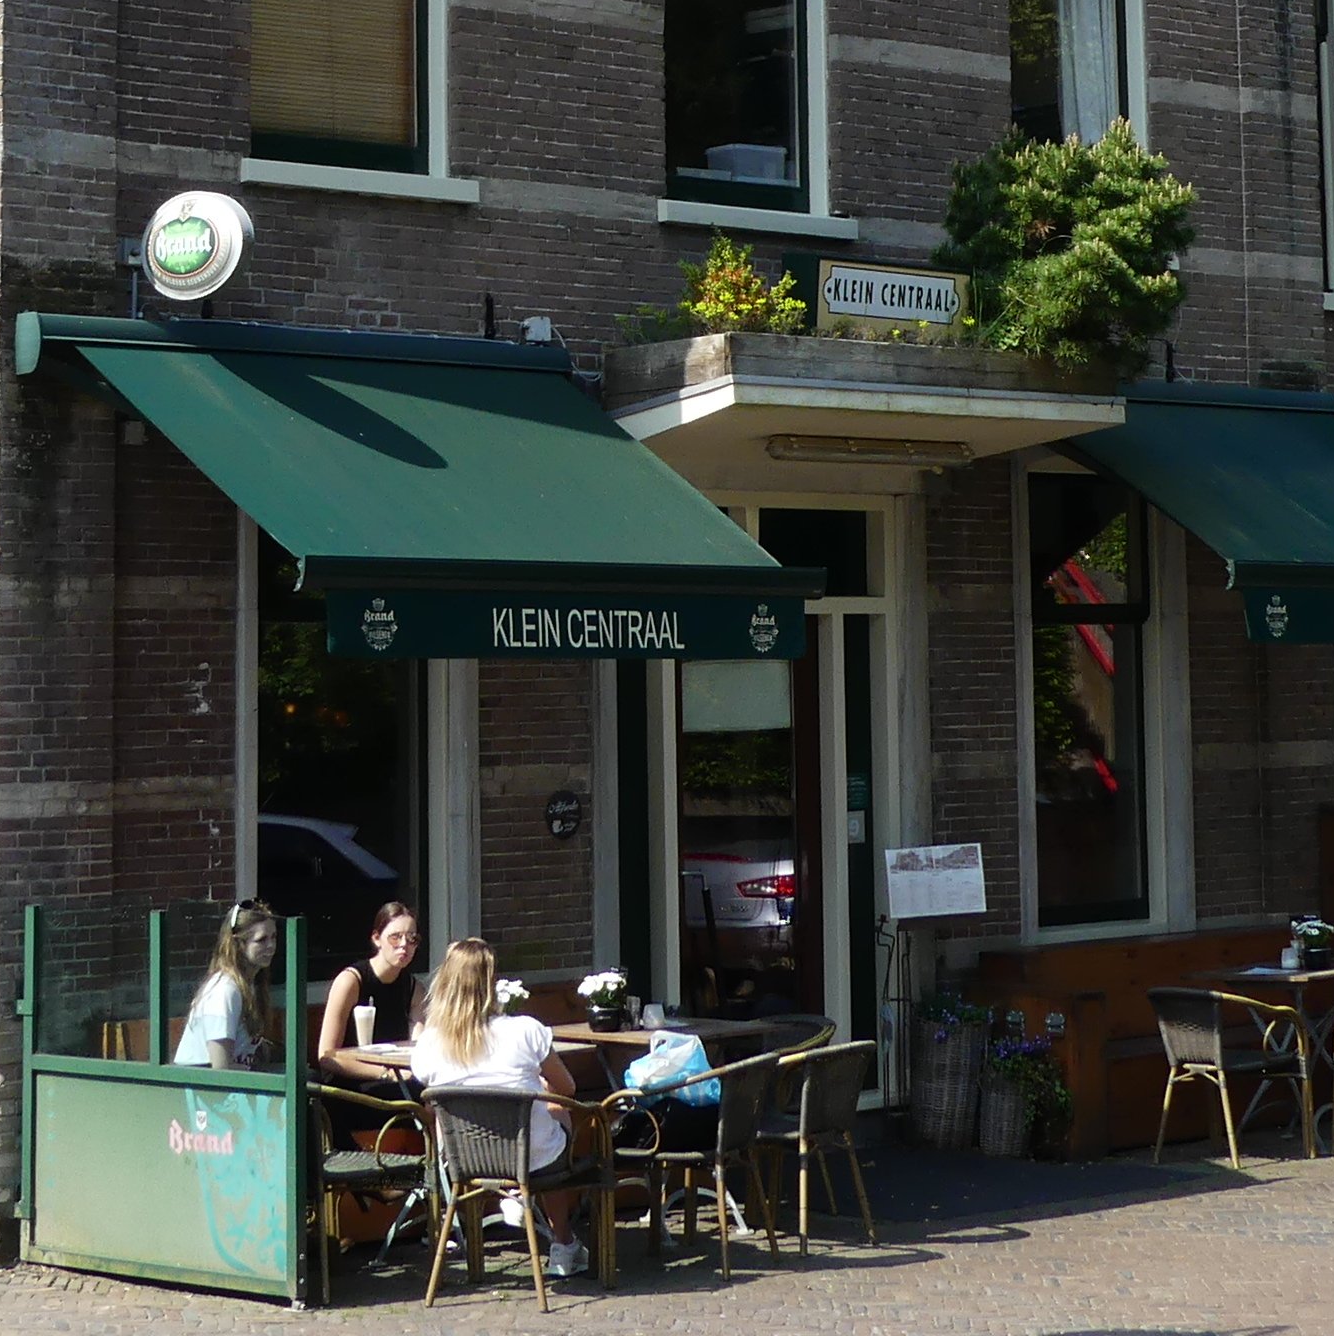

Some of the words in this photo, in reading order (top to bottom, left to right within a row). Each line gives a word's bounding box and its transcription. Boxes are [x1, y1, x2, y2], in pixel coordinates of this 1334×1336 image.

[154, 227, 213, 262] Brand
[833, 277, 874, 304] KLEIN
[881, 282, 950, 312] CENTRAAL
[364, 608, 395, 623] Brand
[492, 607, 561, 648] KLEIN
[567, 608, 686, 649] CENTRAAL
[169, 1117, 234, 1155] Brand
